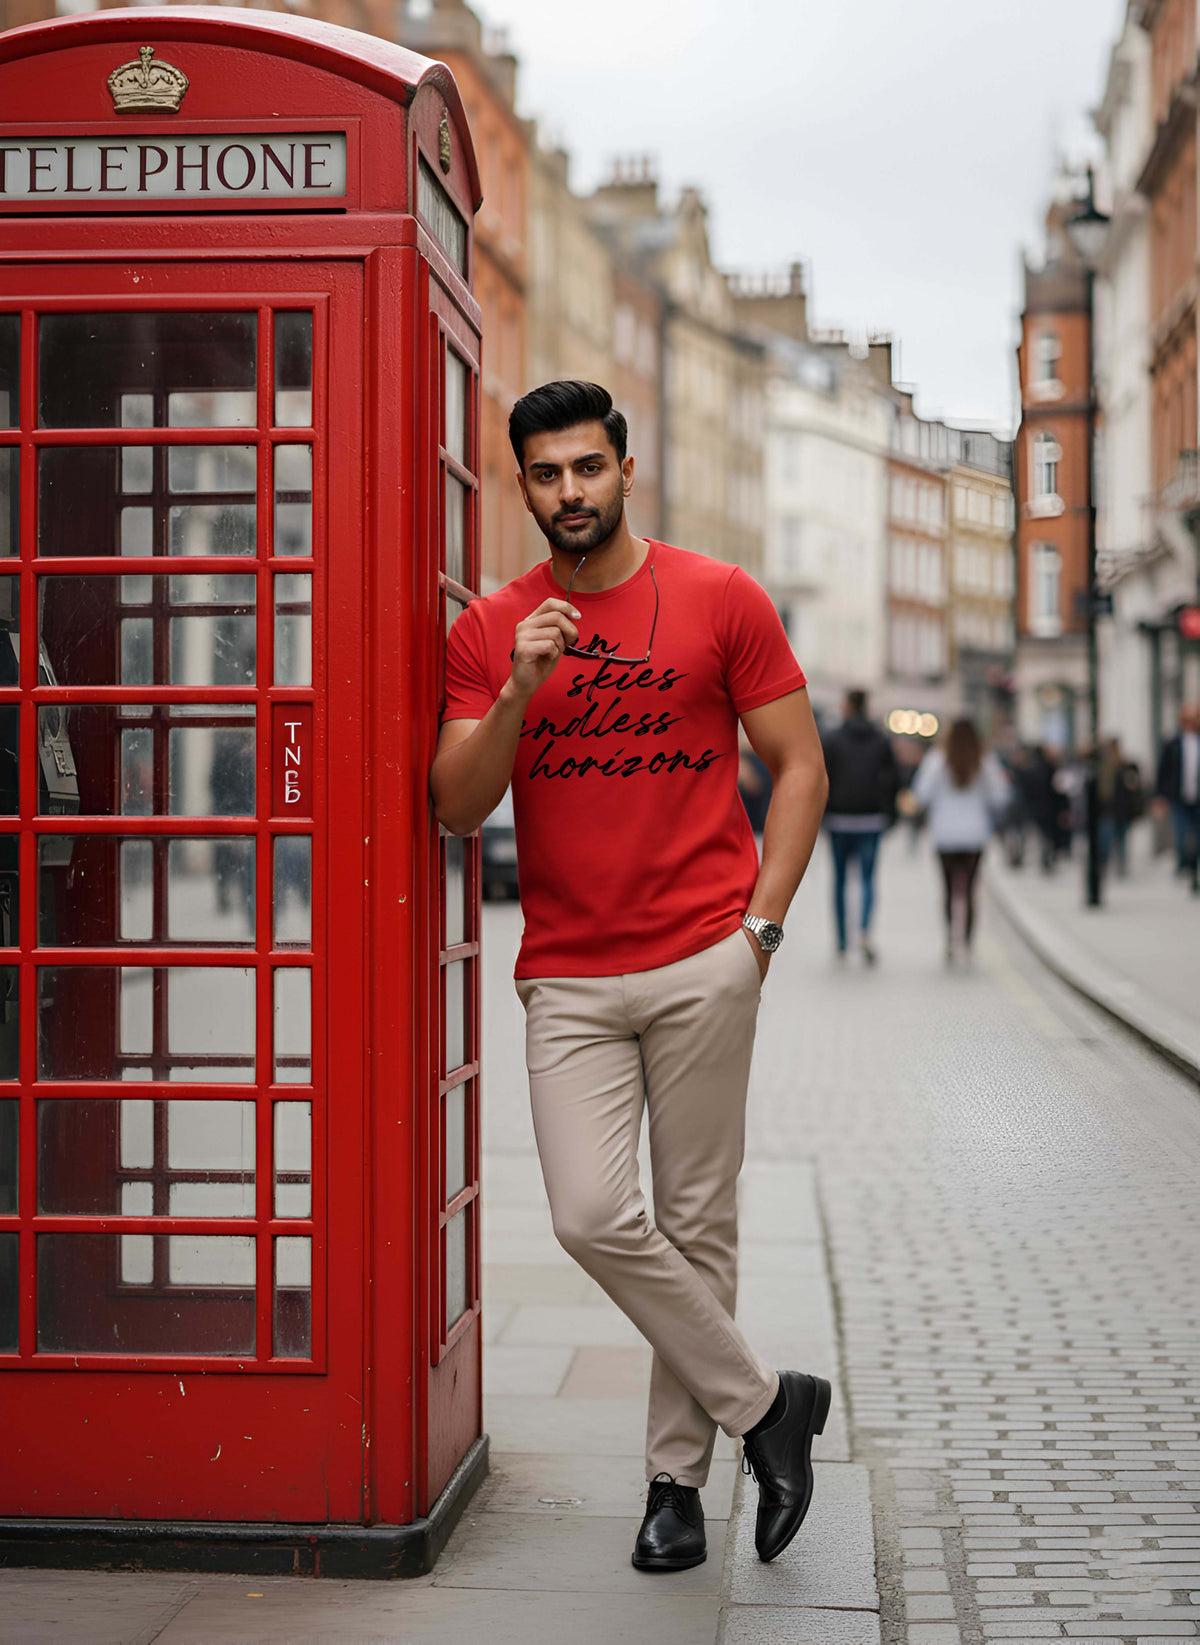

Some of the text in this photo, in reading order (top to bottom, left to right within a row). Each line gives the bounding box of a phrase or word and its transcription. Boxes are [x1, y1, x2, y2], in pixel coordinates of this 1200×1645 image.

[0, 143, 333, 193] TELEPHONE
[567, 659, 690, 702] skies
[529, 740, 727, 779] horizons
